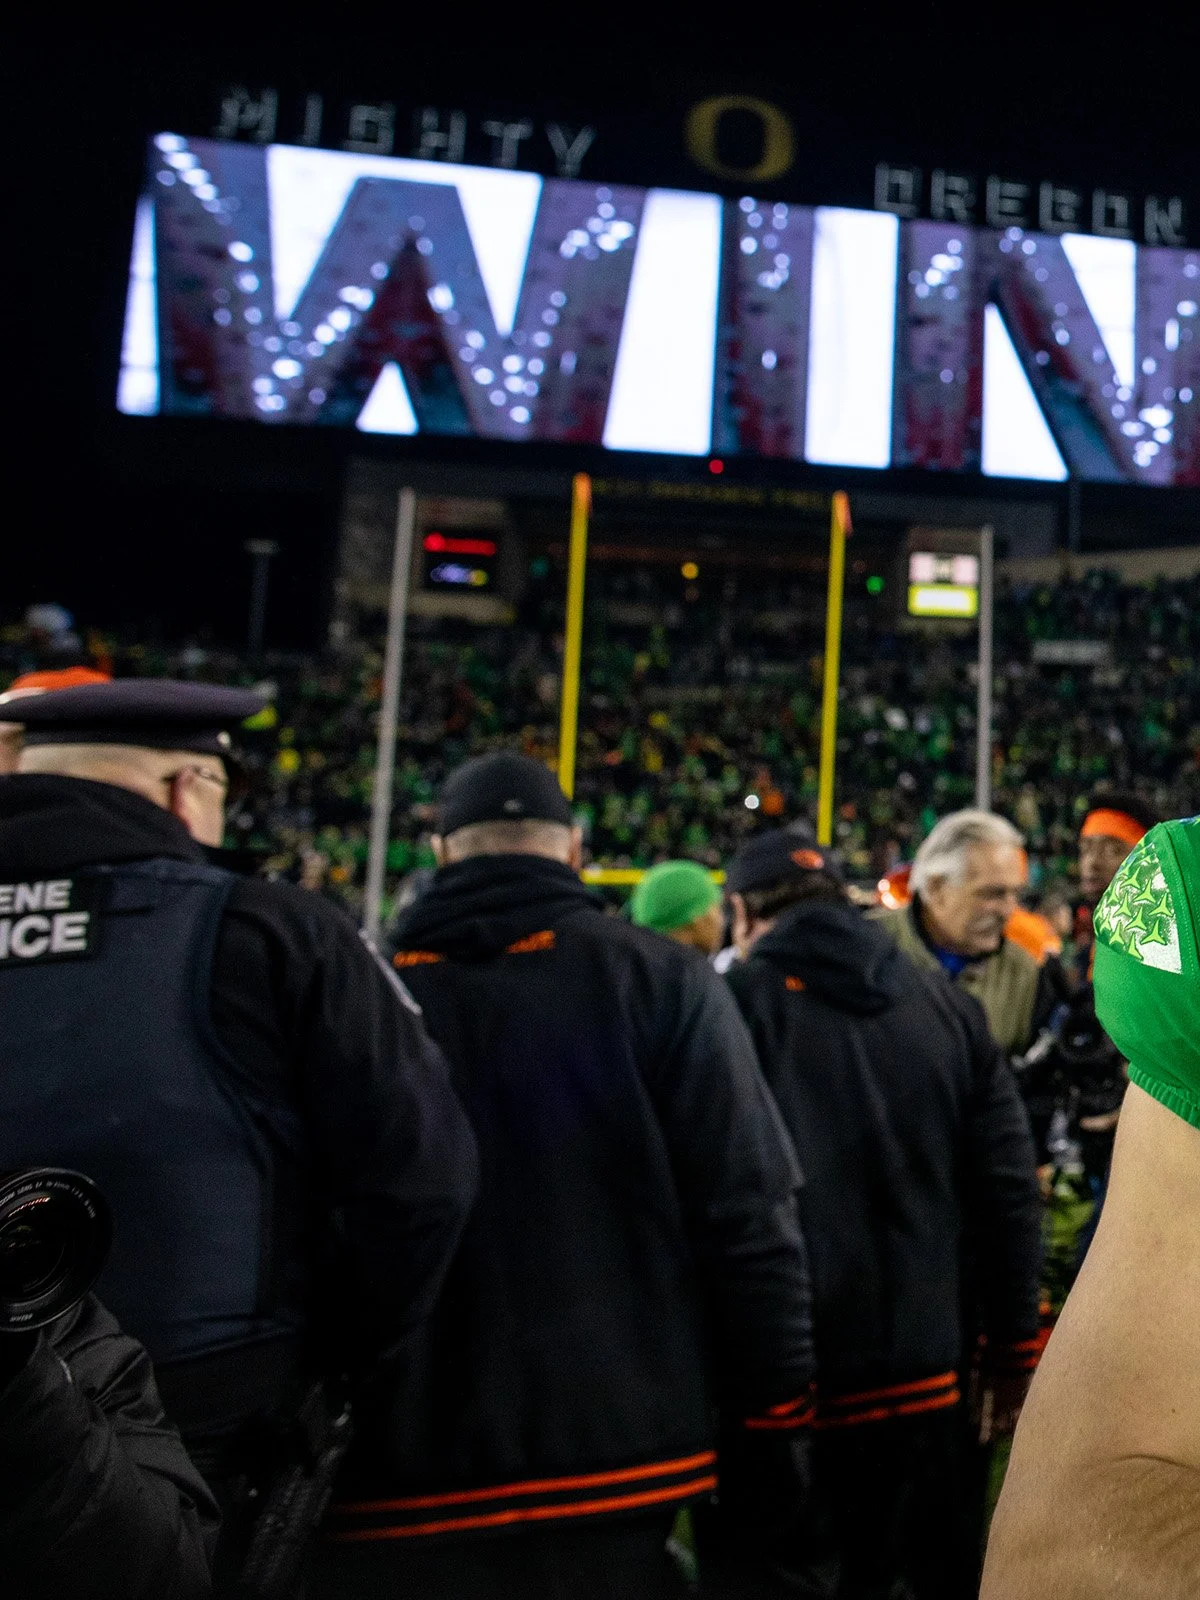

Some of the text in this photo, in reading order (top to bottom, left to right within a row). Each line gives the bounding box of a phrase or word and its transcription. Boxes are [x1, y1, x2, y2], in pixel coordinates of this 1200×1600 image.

[213, 84, 598, 178] MIGHTY
[683, 95, 797, 182] O
[873, 161, 1187, 246] OREGON
[0, 911, 91, 959] ICE
